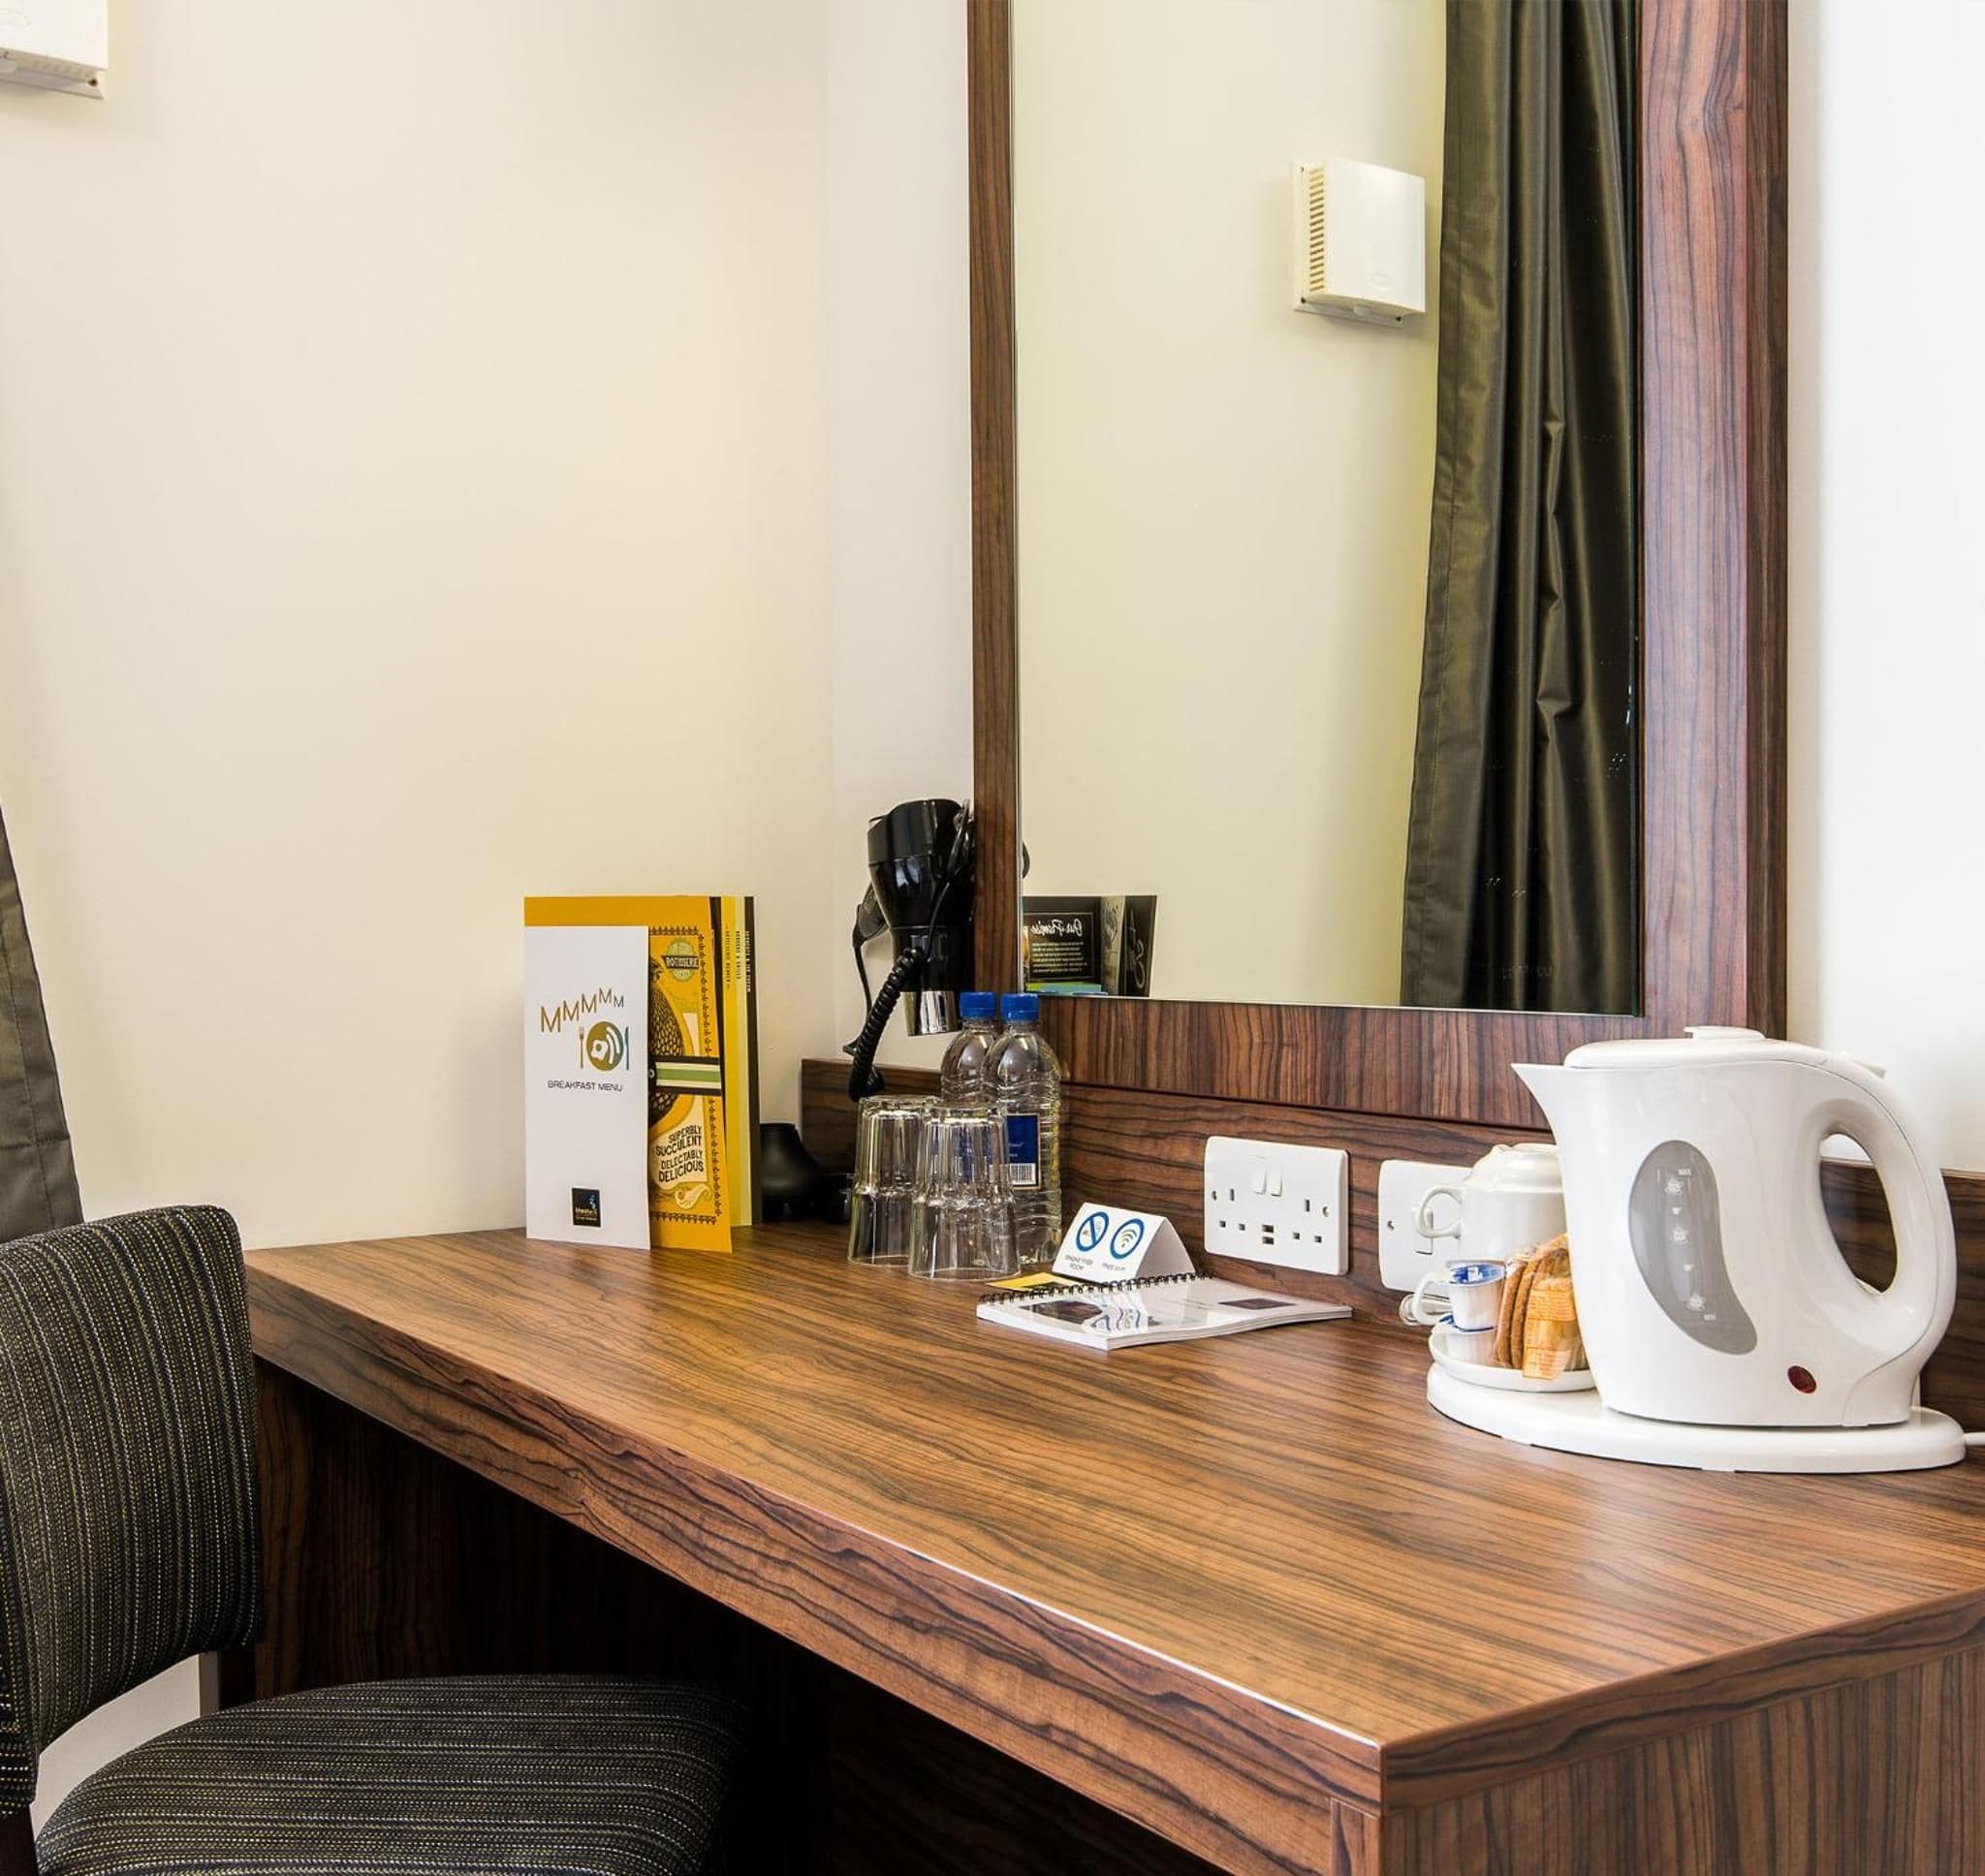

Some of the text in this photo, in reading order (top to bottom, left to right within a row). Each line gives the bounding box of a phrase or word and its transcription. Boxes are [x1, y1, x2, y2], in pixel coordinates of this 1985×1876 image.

[666, 956, 699, 968] ROTISSERIE
[547, 1079, 623, 1092] BREAKFAST MENU
[669, 1124, 702, 1143] SUPERBLY
[655, 1135, 702, 1157] SUCCULENT
[661, 1149, 703, 1170] DELECTABLY
[659, 1161, 704, 1182] DELICIOUS
